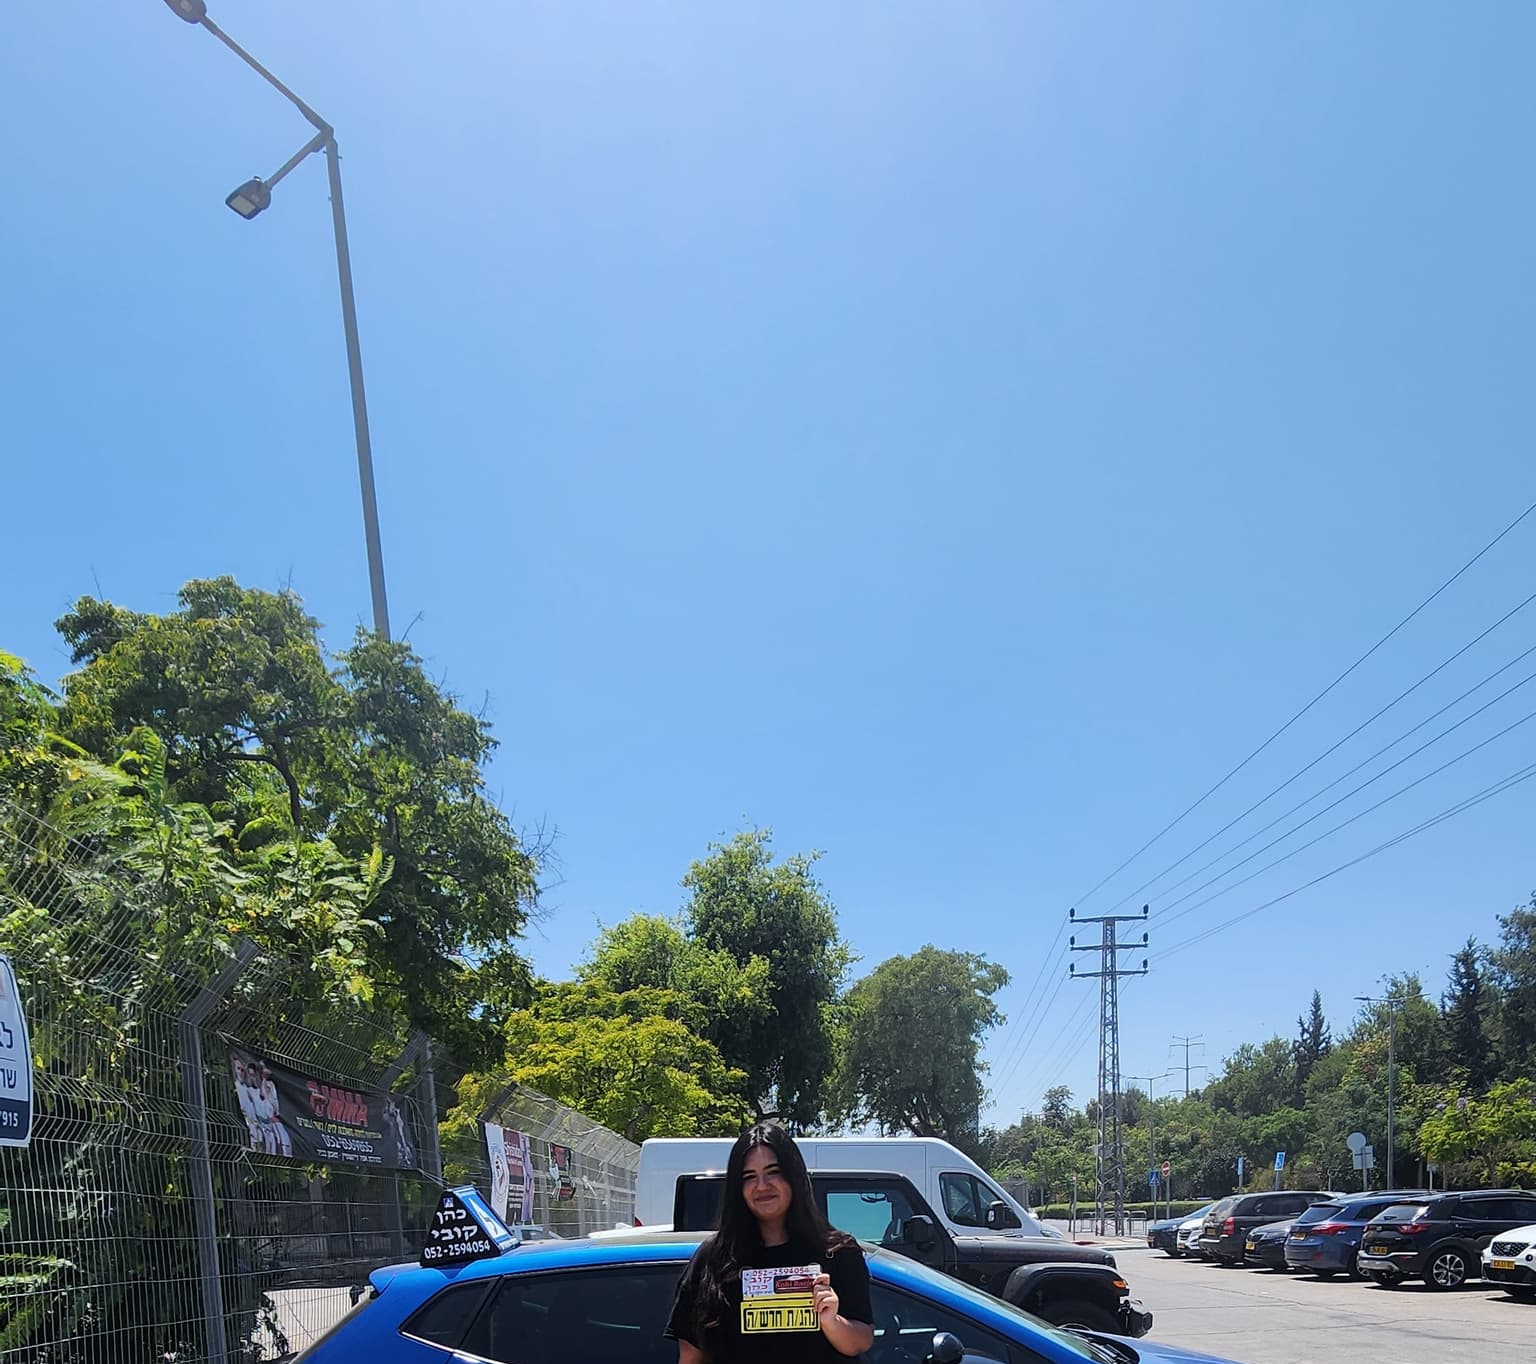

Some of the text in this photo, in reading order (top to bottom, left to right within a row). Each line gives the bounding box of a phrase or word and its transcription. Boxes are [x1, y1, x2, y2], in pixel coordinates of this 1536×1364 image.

[436, 1208, 467, 1225] כהן
[431, 1225, 478, 1242] קובי
[424, 1240, 490, 1260] 052-2594054
[748, 1309, 815, 1328] נהג/ת חדש/ה
